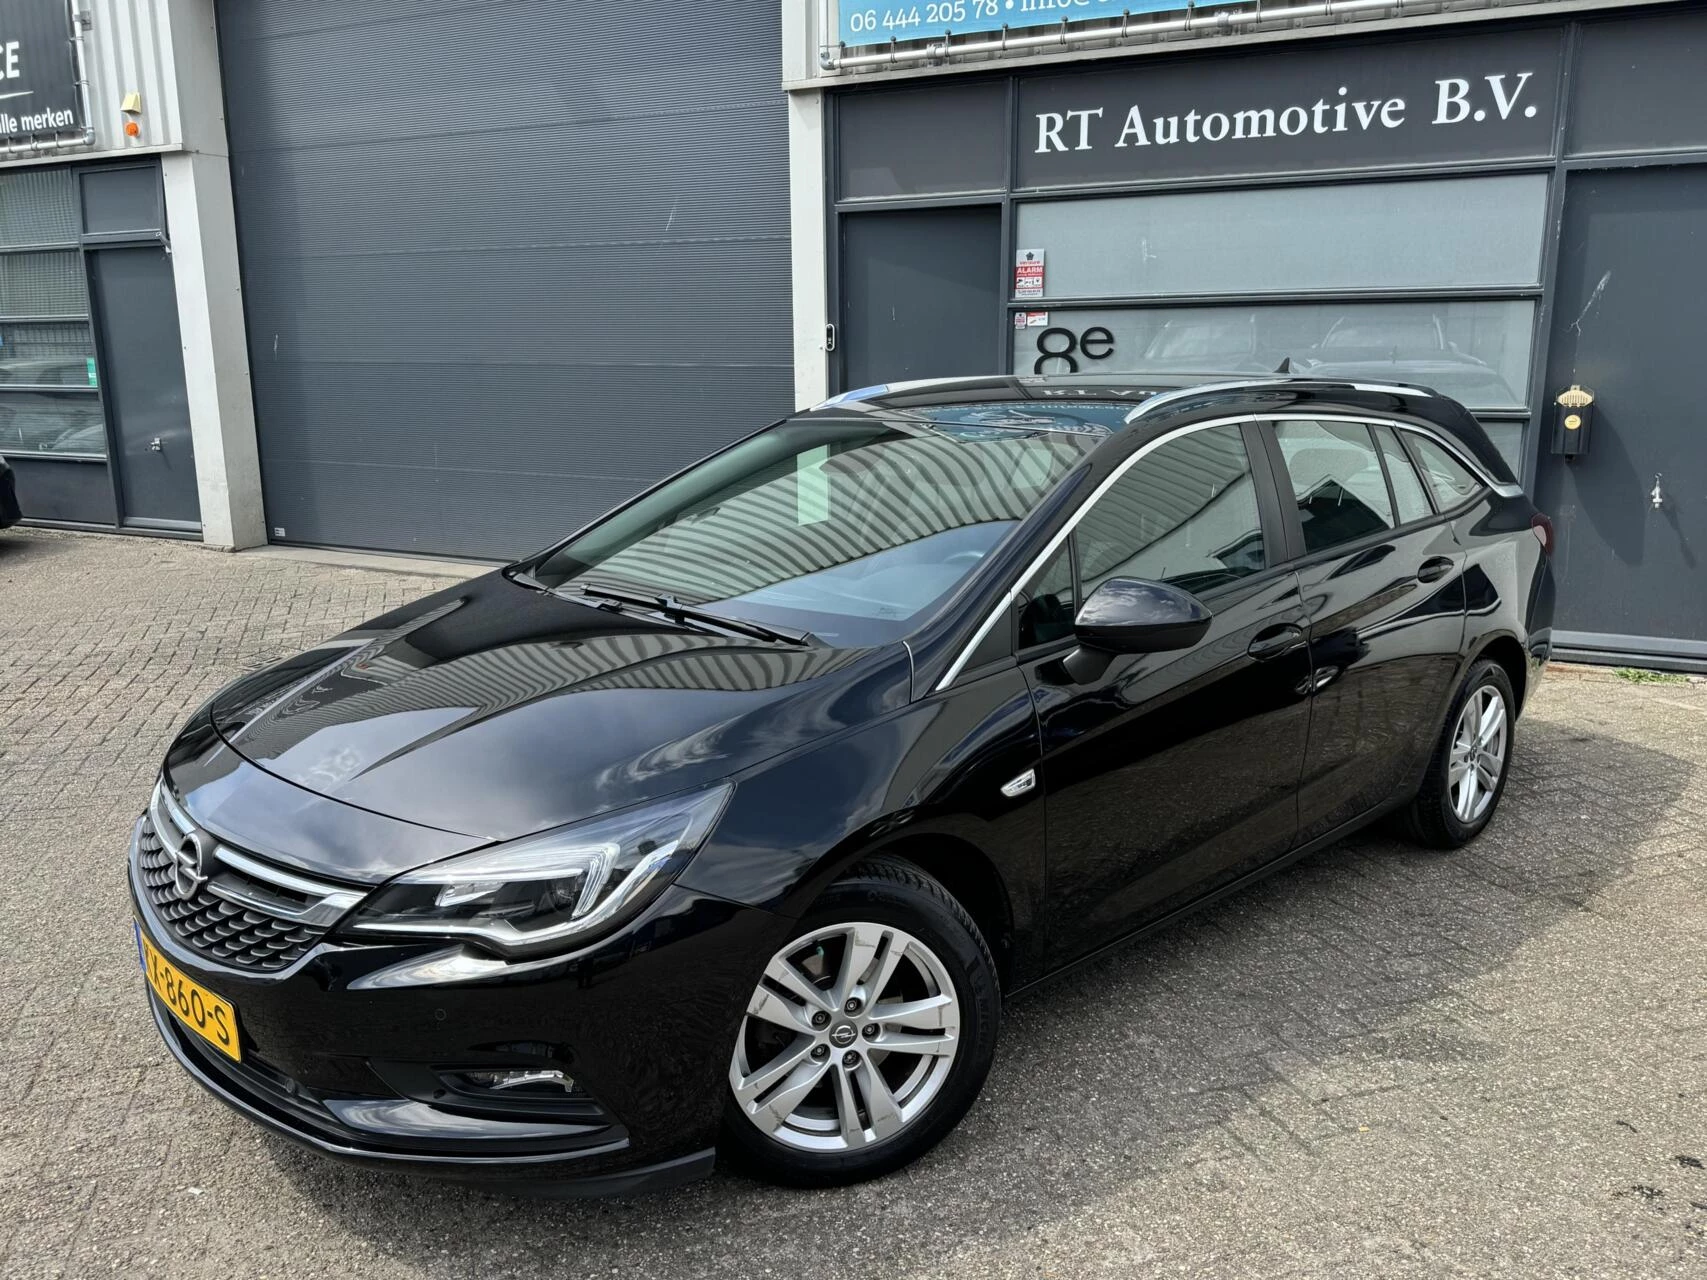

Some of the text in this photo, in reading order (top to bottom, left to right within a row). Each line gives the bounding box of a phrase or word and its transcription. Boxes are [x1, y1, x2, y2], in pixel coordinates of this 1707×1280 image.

[850, 9, 877, 32] 06
[882, 6, 921, 31] 444
[926, 1, 966, 23] 205
[972, 0, 999, 20] 78
[0, 107, 74, 134] lle merken
[1034, 72, 1537, 154] RT Automotive B.V.
[1016, 266, 1043, 274] ALARM
[1034, 326, 1114, 375] 8e
